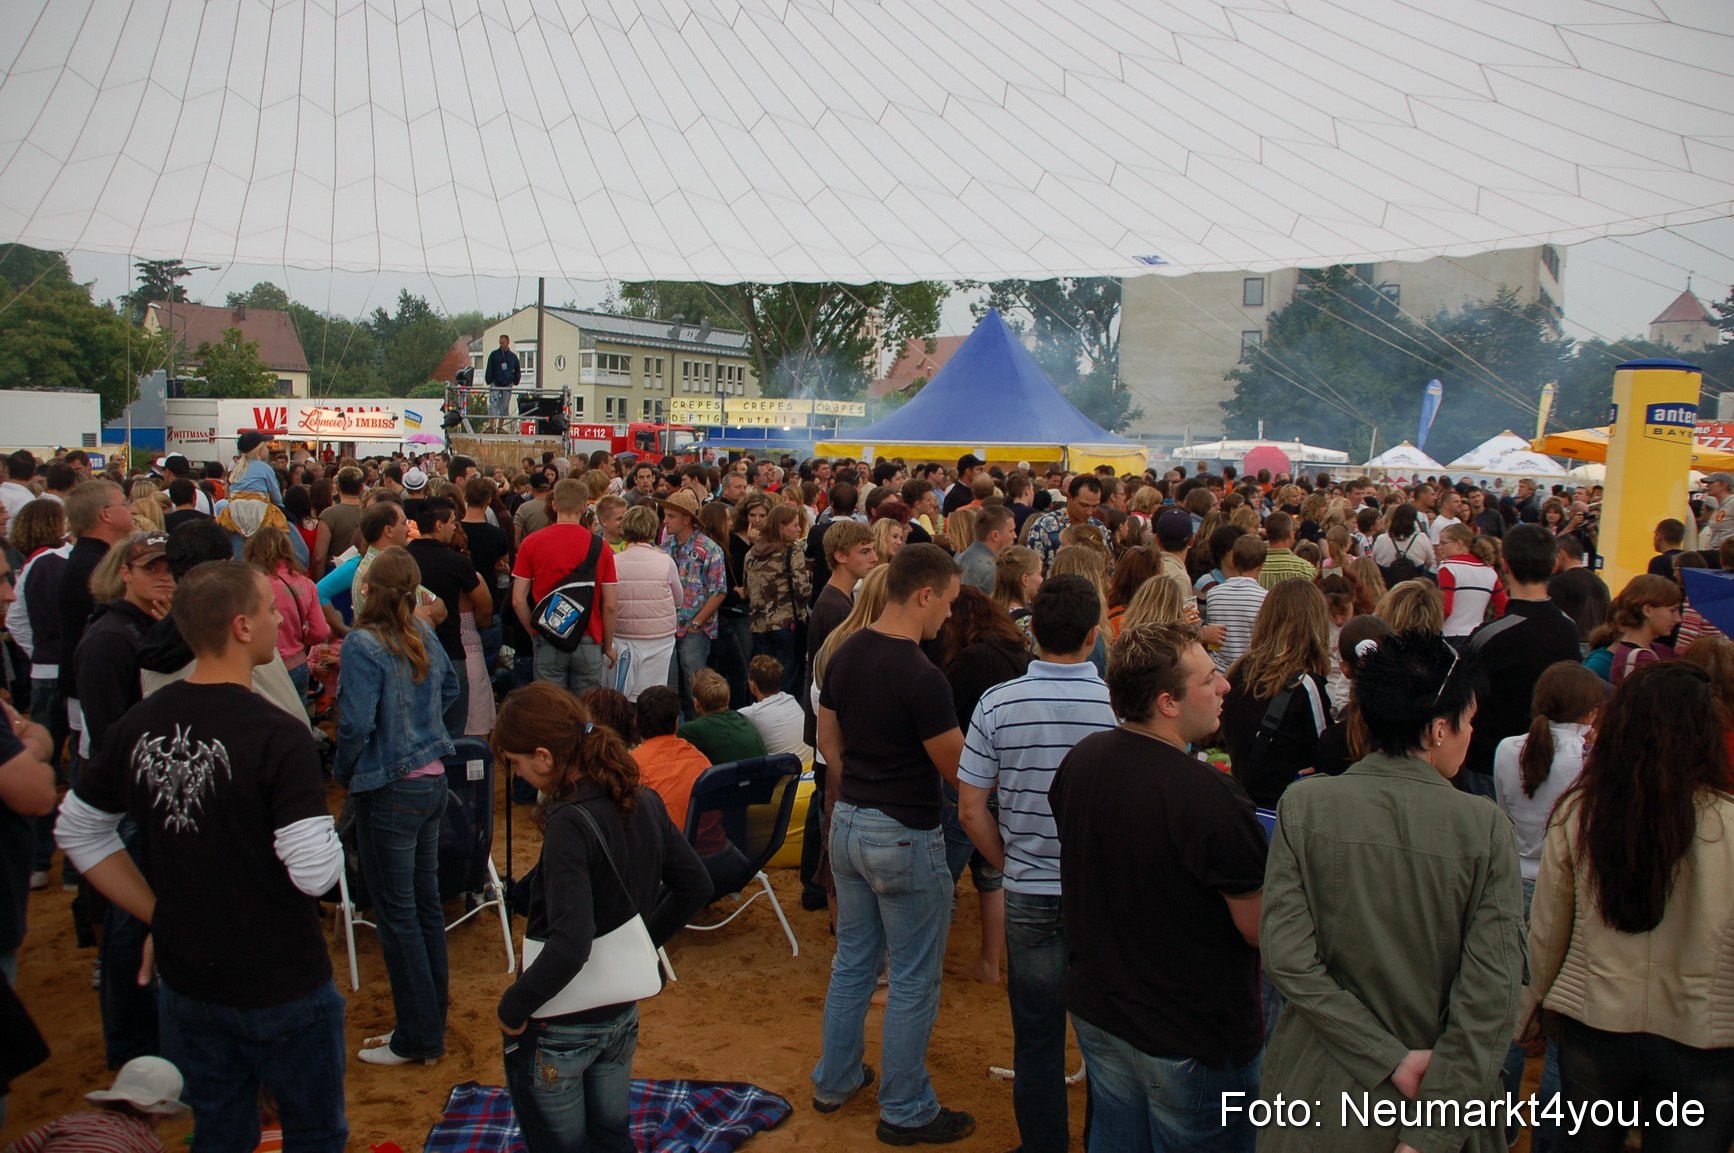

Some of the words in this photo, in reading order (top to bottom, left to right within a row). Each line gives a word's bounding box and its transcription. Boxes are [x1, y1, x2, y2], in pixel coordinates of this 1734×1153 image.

[672, 401, 720, 410] CREPES
[743, 402, 793, 410] CREPES
[672, 413, 720, 423] DEFTIG
[739, 415, 796, 424] nutella
[355, 417, 396, 429] IMBISS
[593, 428, 606, 438] 112
